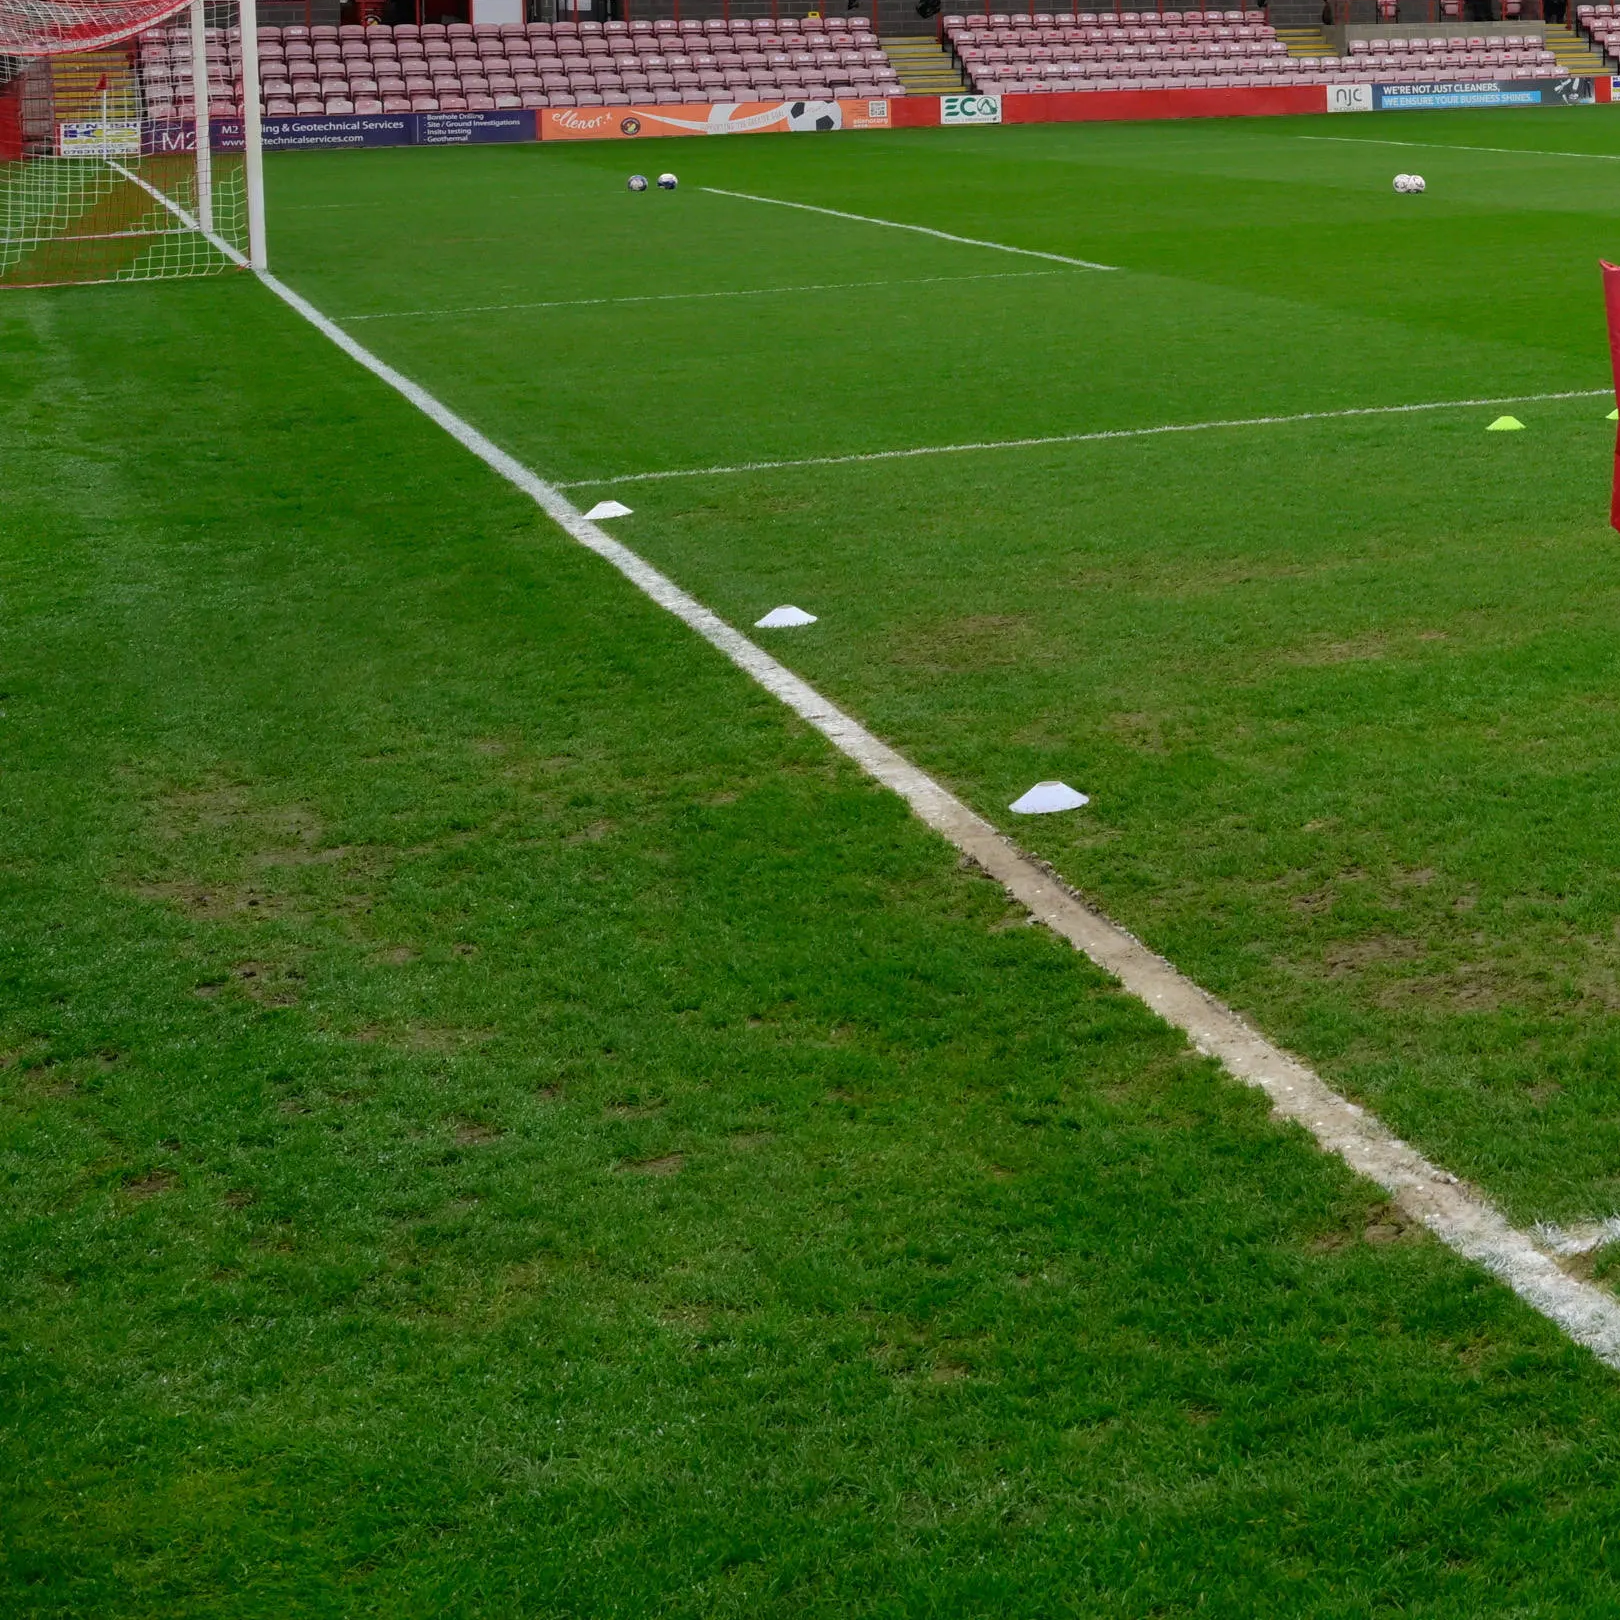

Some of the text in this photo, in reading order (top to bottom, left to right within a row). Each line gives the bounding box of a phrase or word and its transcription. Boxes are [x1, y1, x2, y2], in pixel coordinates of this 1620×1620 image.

[1383, 82, 1501, 95] WE'RE NOT JUST CLEANERS,
[1383, 96, 1399, 107] WE
[1399, 95, 1434, 106] ENSURE
[1435, 94, 1460, 105] YOUR
[1460, 93, 1500, 105] BUSINESS
[427, 113, 484, 122] Borehole Drilling
[445, 120, 472, 128] Ground
[473, 118, 521, 128] Investigations
[551, 109, 603, 130] ellenor
[222, 125, 238, 135] M2
[282, 123, 290, 132] &
[292, 121, 360, 132] Geotechnical
[362, 120, 405, 129] Services
[447, 127, 472, 137] testing
[427, 134, 468, 143] Geothermal
